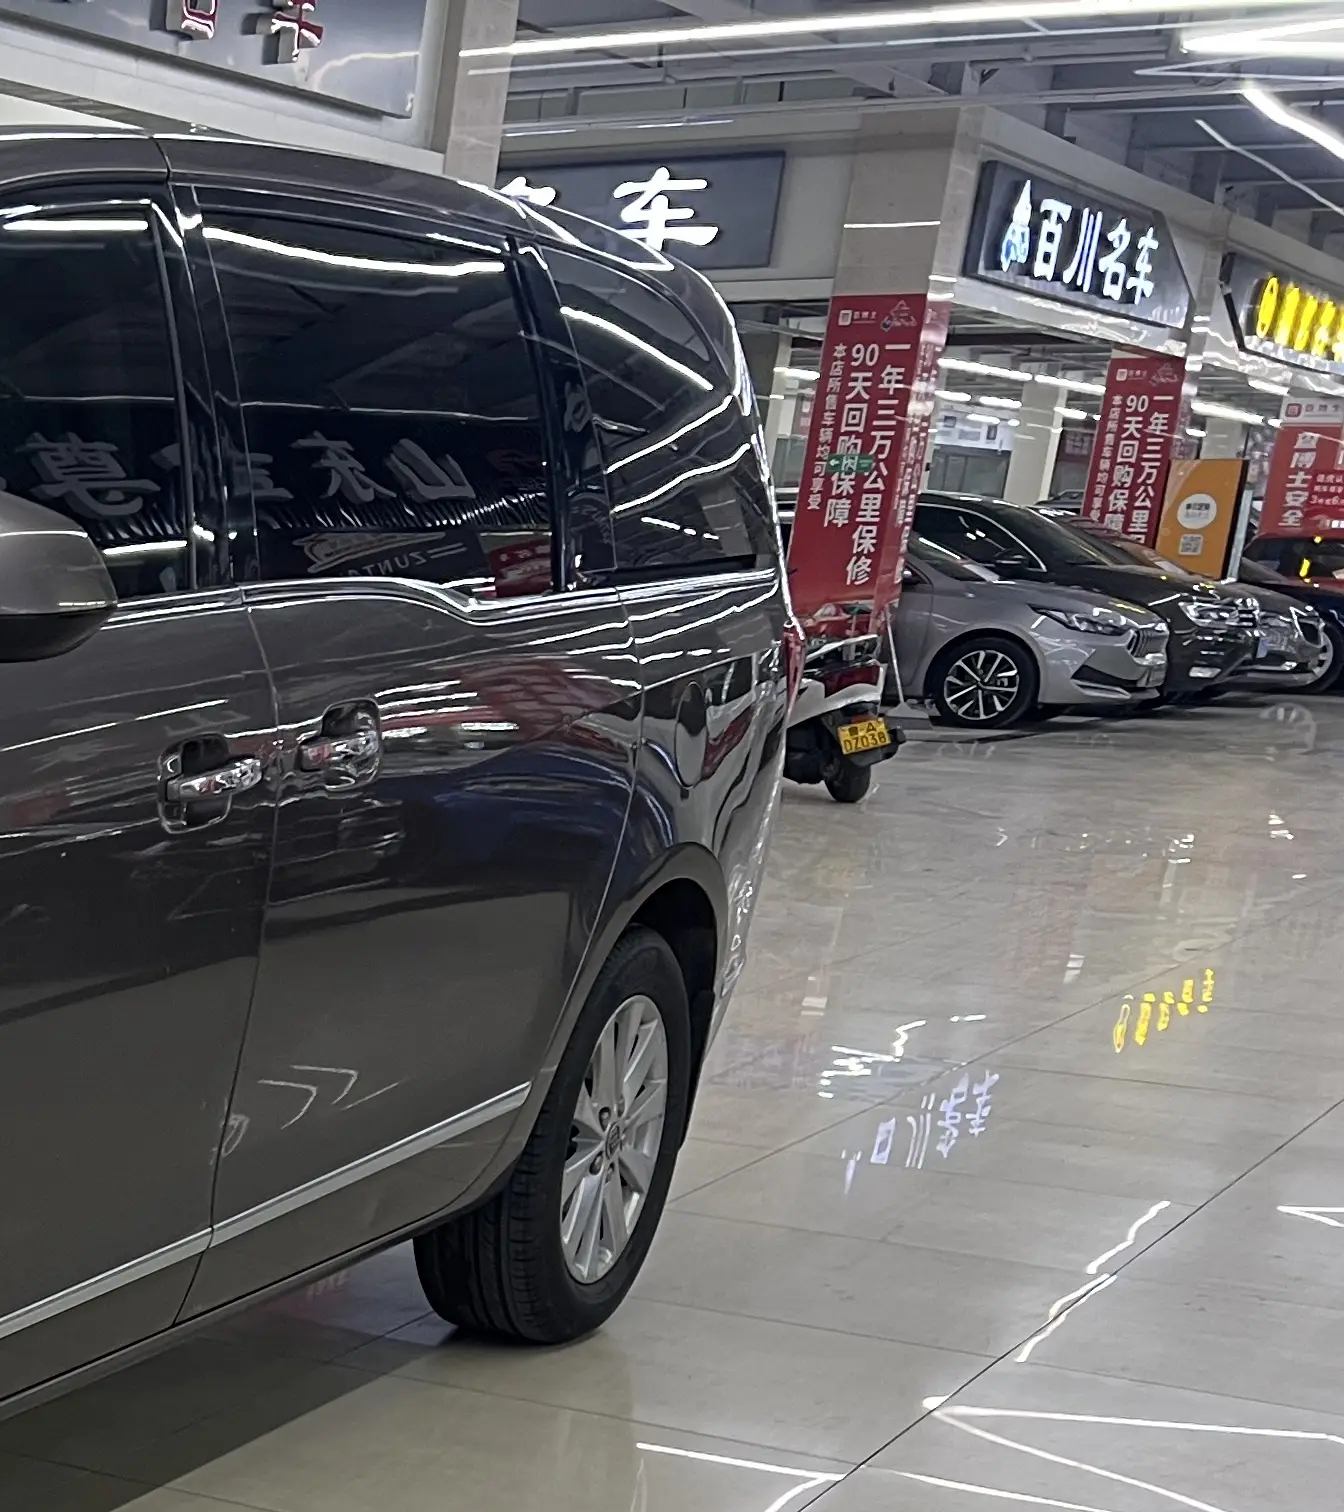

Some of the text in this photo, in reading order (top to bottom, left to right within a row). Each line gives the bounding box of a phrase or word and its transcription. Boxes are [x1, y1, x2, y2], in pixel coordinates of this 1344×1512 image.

[1033, 198, 1159, 305] 百川名车
[824, 343, 879, 528] 90天回购保障
[846, 343, 911, 586] 一年三万公里保修
